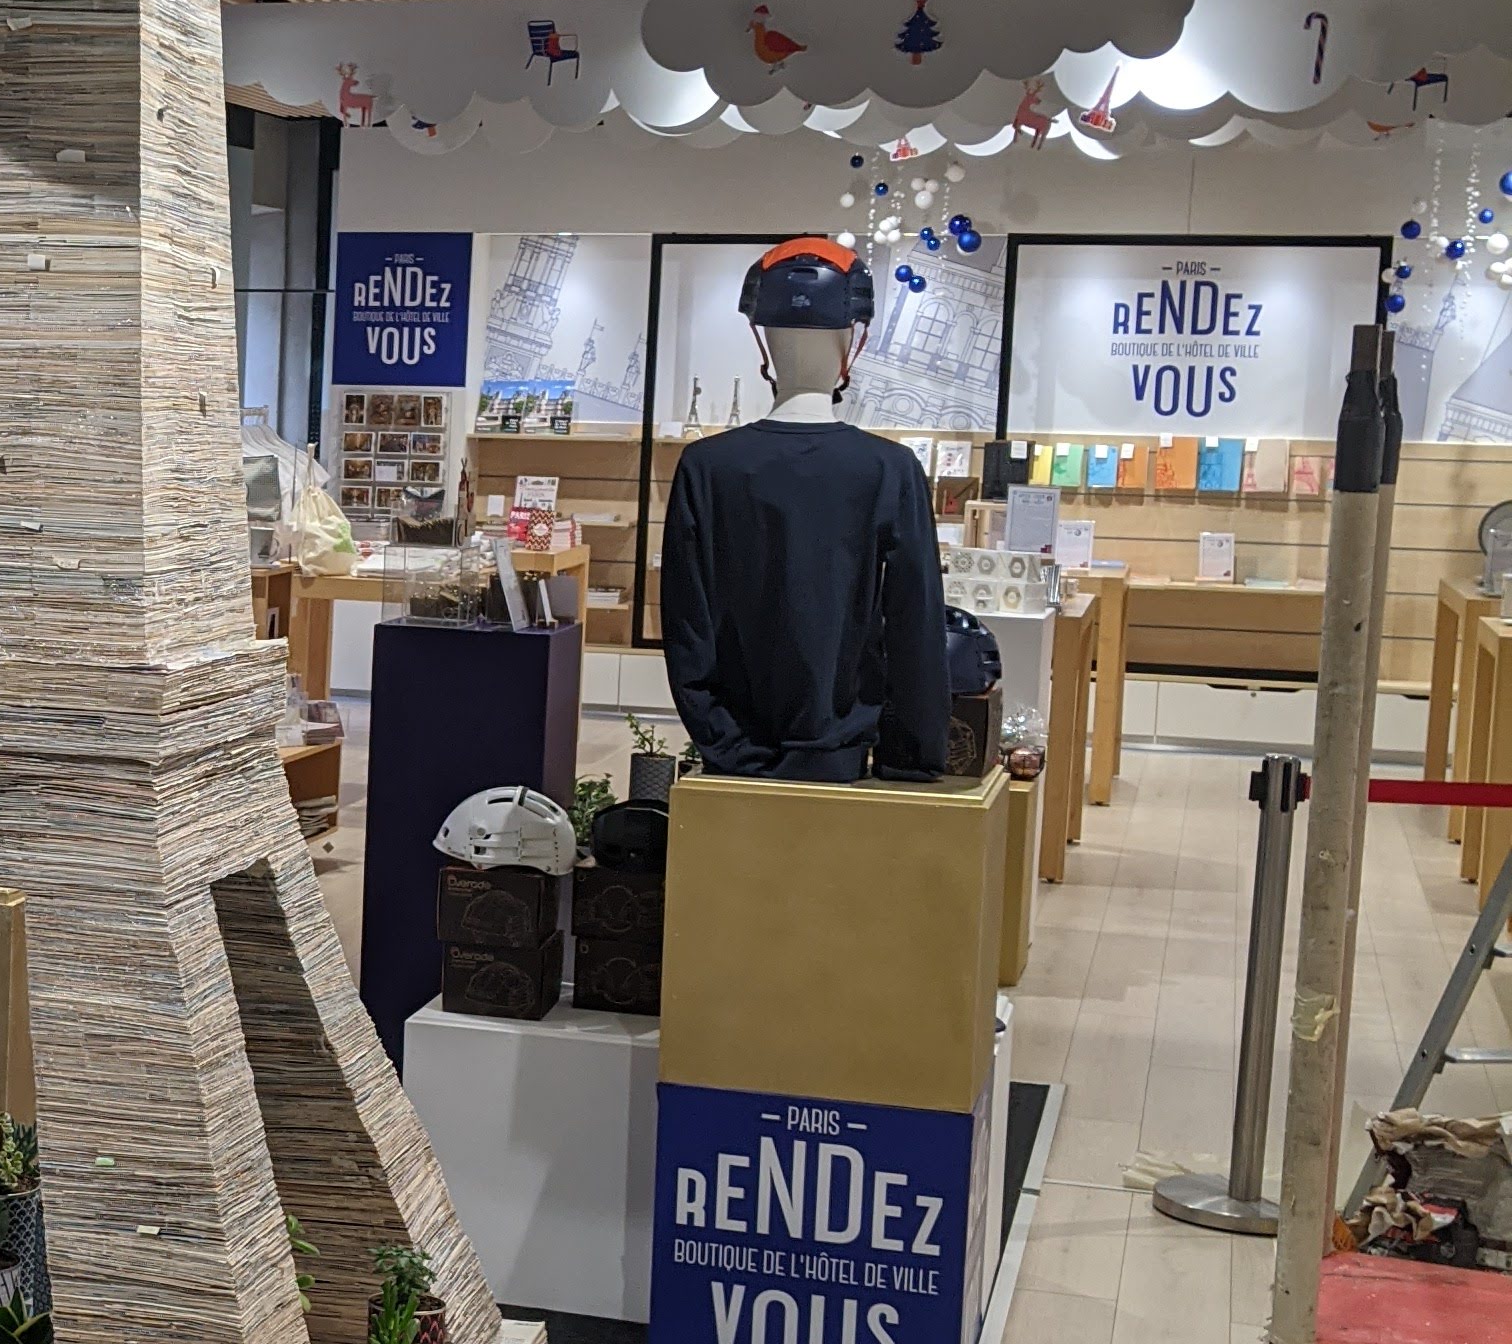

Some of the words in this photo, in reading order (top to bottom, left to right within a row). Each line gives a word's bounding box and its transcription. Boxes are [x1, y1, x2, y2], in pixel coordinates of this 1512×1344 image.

[393, 253, 415, 264] PARIS
[1176, 261, 1207, 276] PARIS
[352, 311, 385, 323] BOUTIQUE
[385, 312, 395, 323] DE
[422, 312, 431, 323] DE
[432, 312, 450, 323] VILLE
[1110, 342, 1159, 357] BOUTIQUE
[1161, 342, 1175, 357] DE
[1176, 340, 1215, 358] L'HÔTEL
[1217, 344, 1231, 358] DE
[1233, 344, 1260, 359] VILLE
[787, 1105, 841, 1136] PARIS
[673, 1238, 759, 1273] BOUTIQUE
[762, 1249, 786, 1276] DE
[790, 1252, 859, 1286] L'HÔTEL
[864, 1264, 887, 1289] DE
[892, 1266, 940, 1296] VILLE
